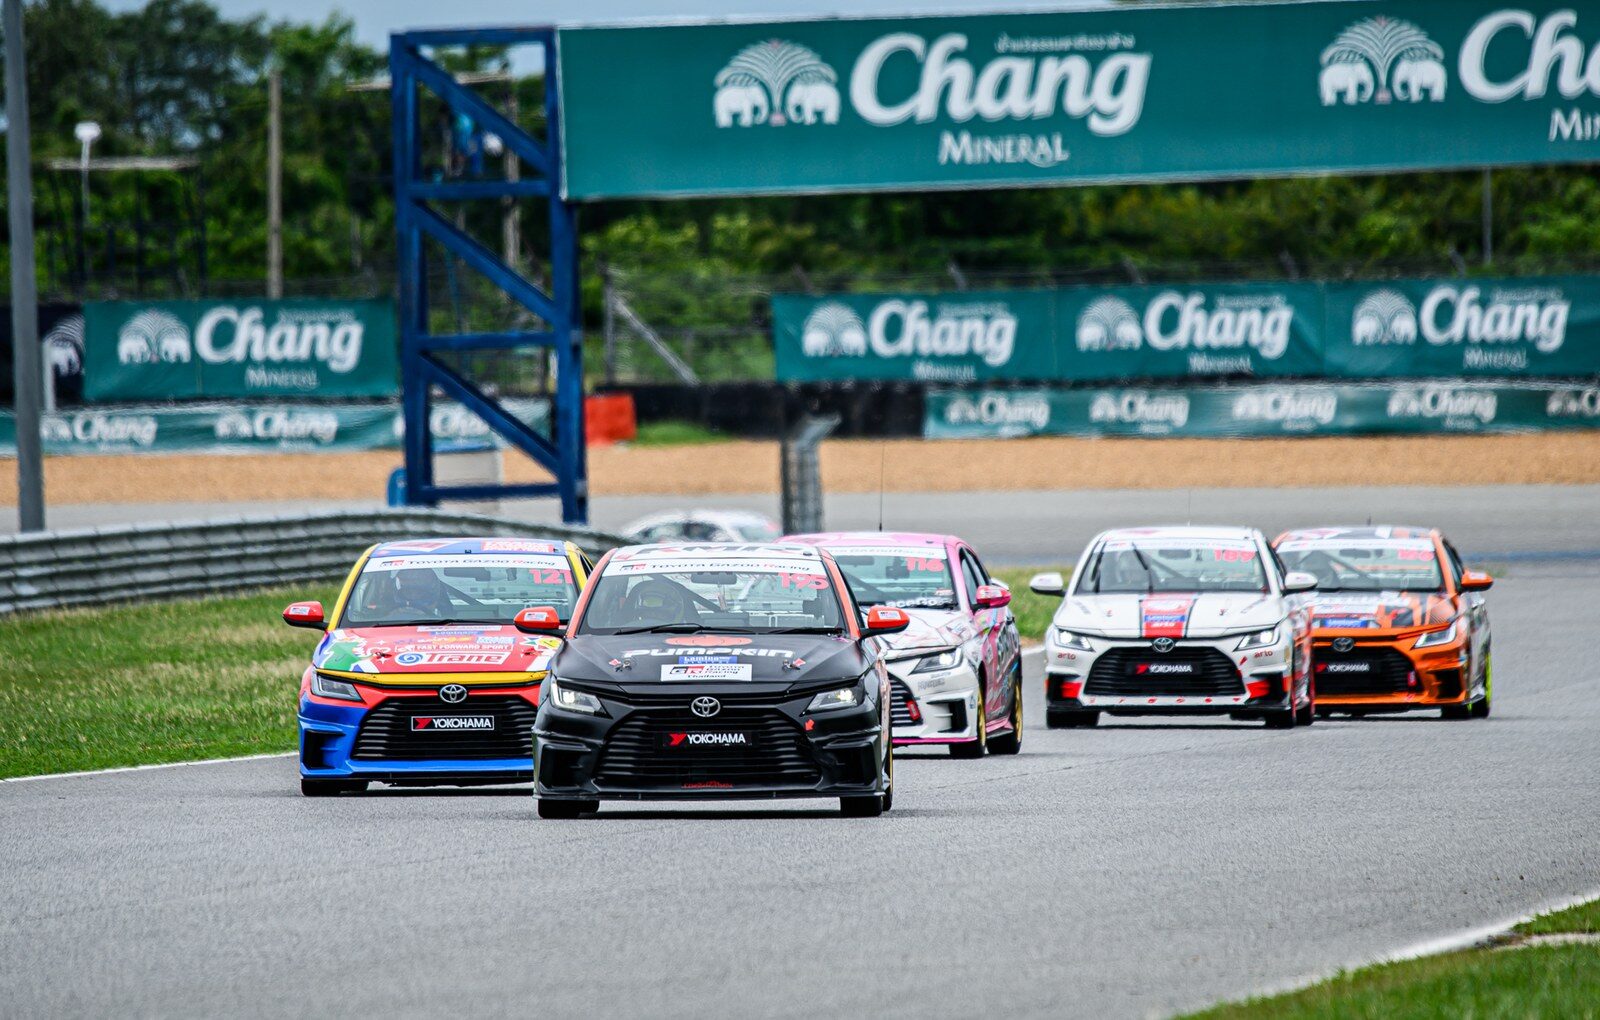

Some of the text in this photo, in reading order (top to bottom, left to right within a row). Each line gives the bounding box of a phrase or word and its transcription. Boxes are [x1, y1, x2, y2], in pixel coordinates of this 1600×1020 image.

[1458, 9, 1600, 103] Ch
[849, 32, 1152, 136] Chang
[938, 131, 1070, 167] MINERAL
[868, 299, 1018, 367] Chang
[1144, 291, 1294, 359] Chang
[1420, 285, 1571, 352] Chang
[195, 306, 364, 373] Chang
[979, 395, 1050, 429] Chang
[1120, 392, 1190, 427] Chang
[1265, 388, 1337, 424] Chang
[1421, 386, 1498, 423] Chang
[73, 413, 157, 445] Chang
[254, 411, 338, 442] Chang
[529, 568, 573, 585] 121
[778, 571, 829, 590] 195
[905, 557, 945, 572] 116
[1150, 664, 1192, 673] YOKOHAMA
[1327, 664, 1370, 672] YOKOHAMA
[432, 718, 491, 728] YOKOHAMA
[687, 733, 745, 744] YOKOHAMA
